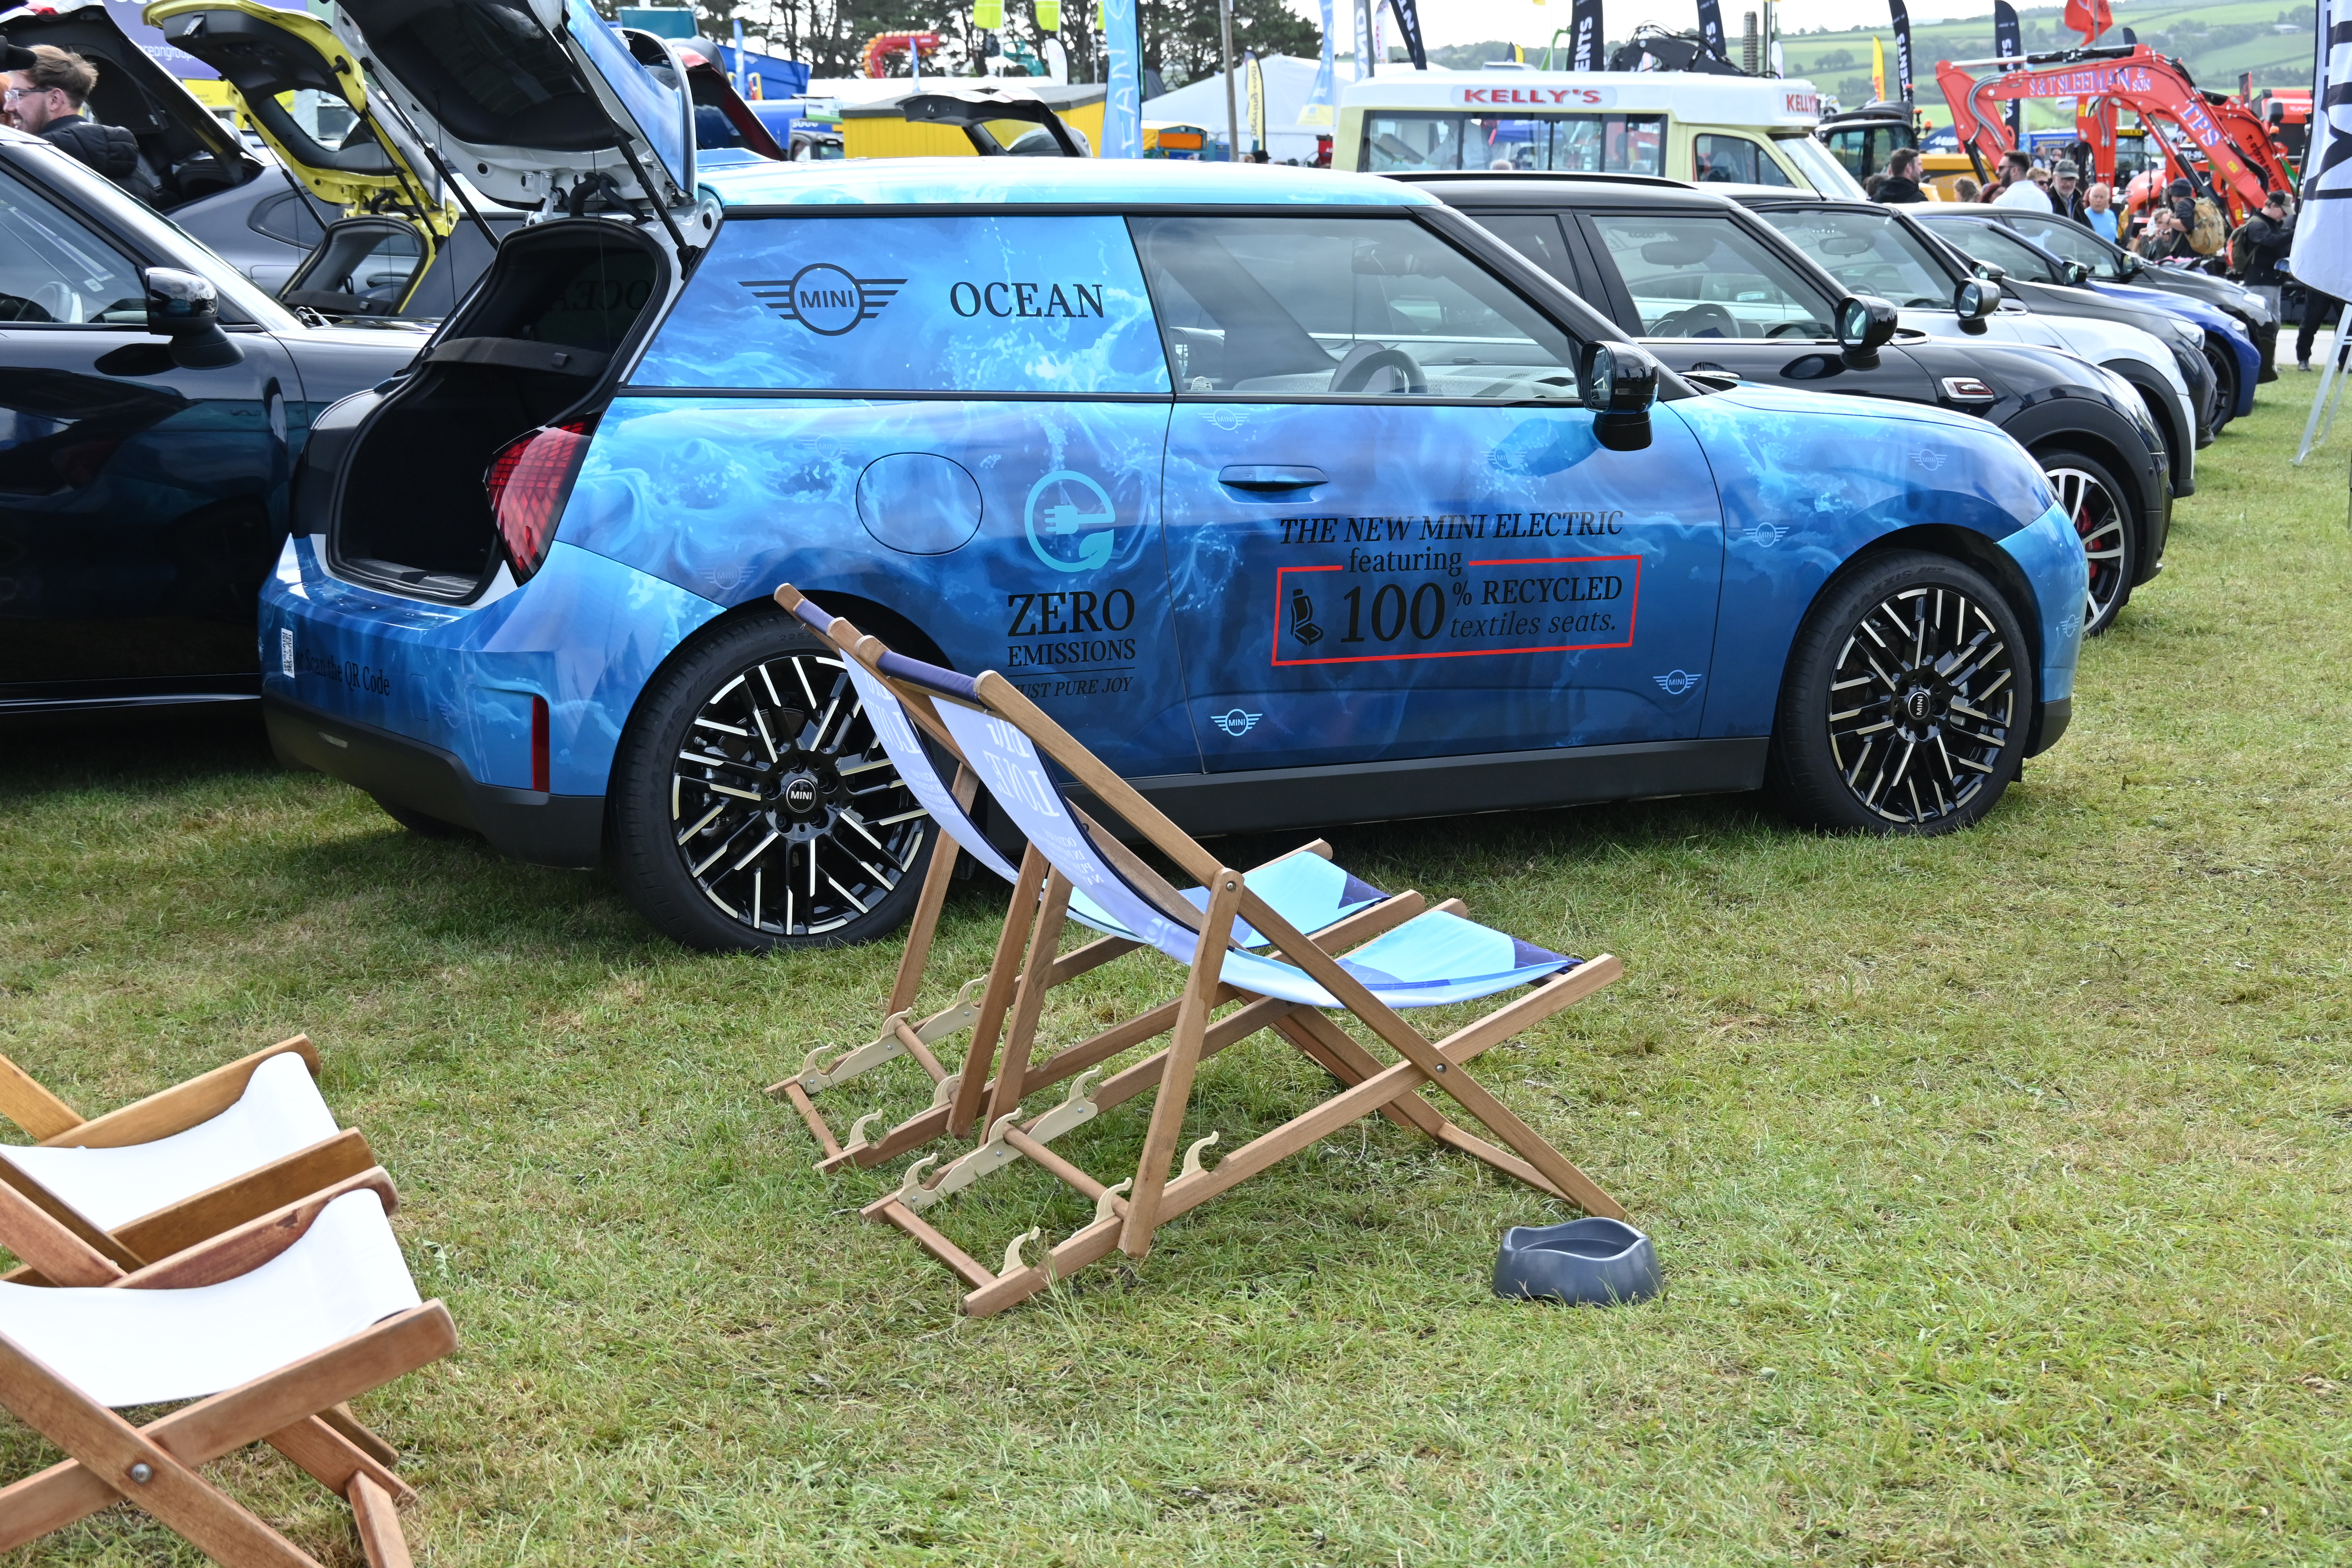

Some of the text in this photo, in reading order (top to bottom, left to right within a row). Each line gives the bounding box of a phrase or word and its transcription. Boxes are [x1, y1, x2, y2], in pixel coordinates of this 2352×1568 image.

[2058, 68, 2130, 95] SLEEMAN
[1465, 89, 1601, 104] KELLY'S
[2179, 100, 2222, 147] TPS
[800, 290, 855, 309] MINI
[950, 282, 1104, 318] OCEAN
[1280, 510, 1624, 544] THE NEW MINI ELECTRIC
[1348, 546, 1462, 577] featuring
[1481, 576, 1622, 605] RECYCLED
[1007, 589, 1135, 637] ZERO
[1450, 610, 1616, 638] textiles seats.
[1007, 639, 1136, 667] EMISSIONS
[328, 655, 343, 683] the
[345, 661, 361, 691] QR
[363, 666, 390, 696] Code
[1054, 679, 1099, 697] PURE
[1102, 677, 1134, 694] JOY
[791, 791, 812, 800] MINI
